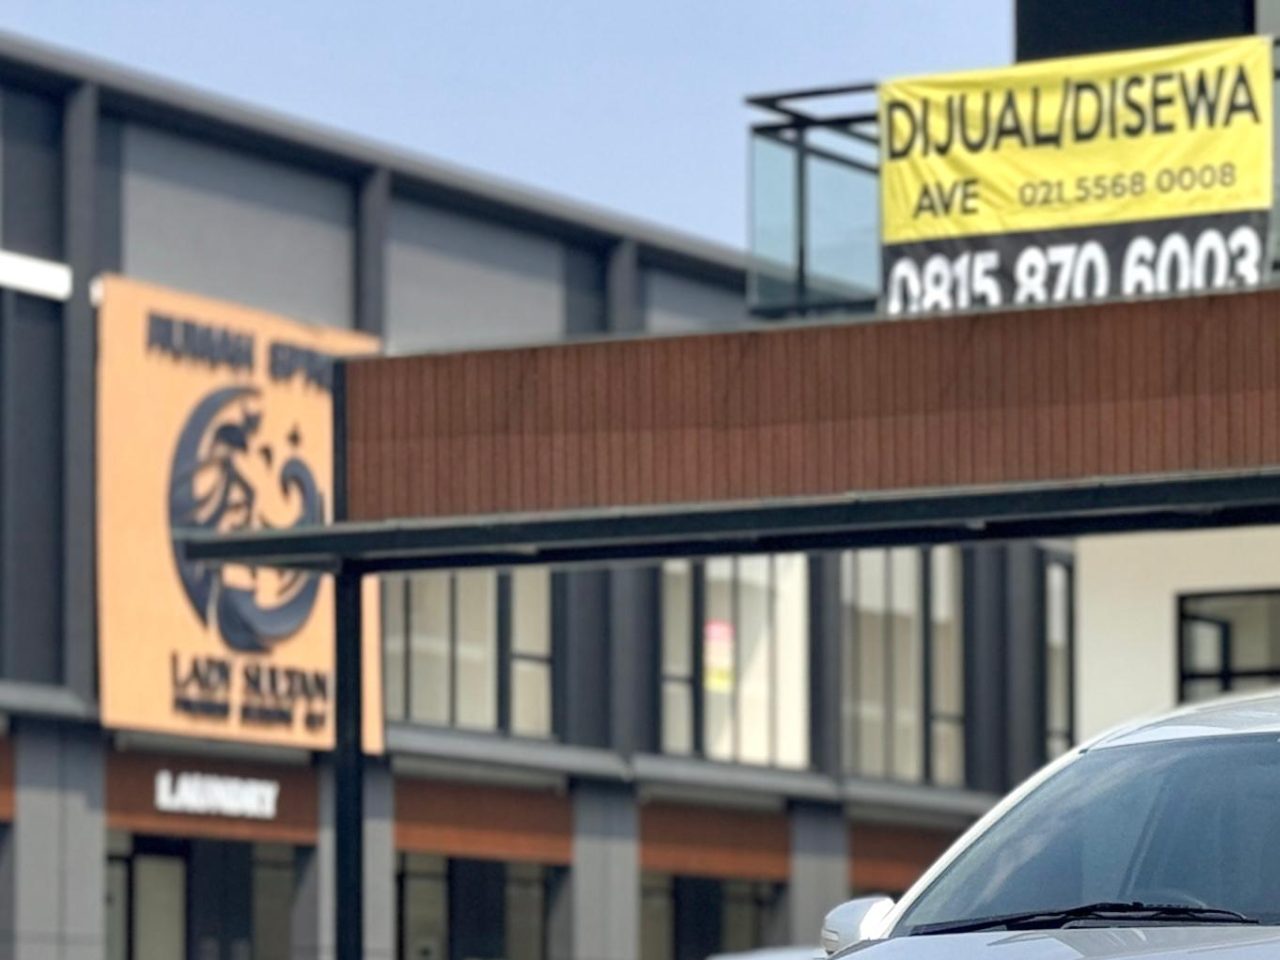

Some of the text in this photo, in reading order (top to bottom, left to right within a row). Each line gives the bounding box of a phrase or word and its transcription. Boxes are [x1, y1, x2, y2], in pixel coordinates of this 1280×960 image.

[886, 64, 1261, 160] DIJUAL/DISEWA
[1155, 161, 1237, 194] 0008
[912, 178, 980, 219] AVE
